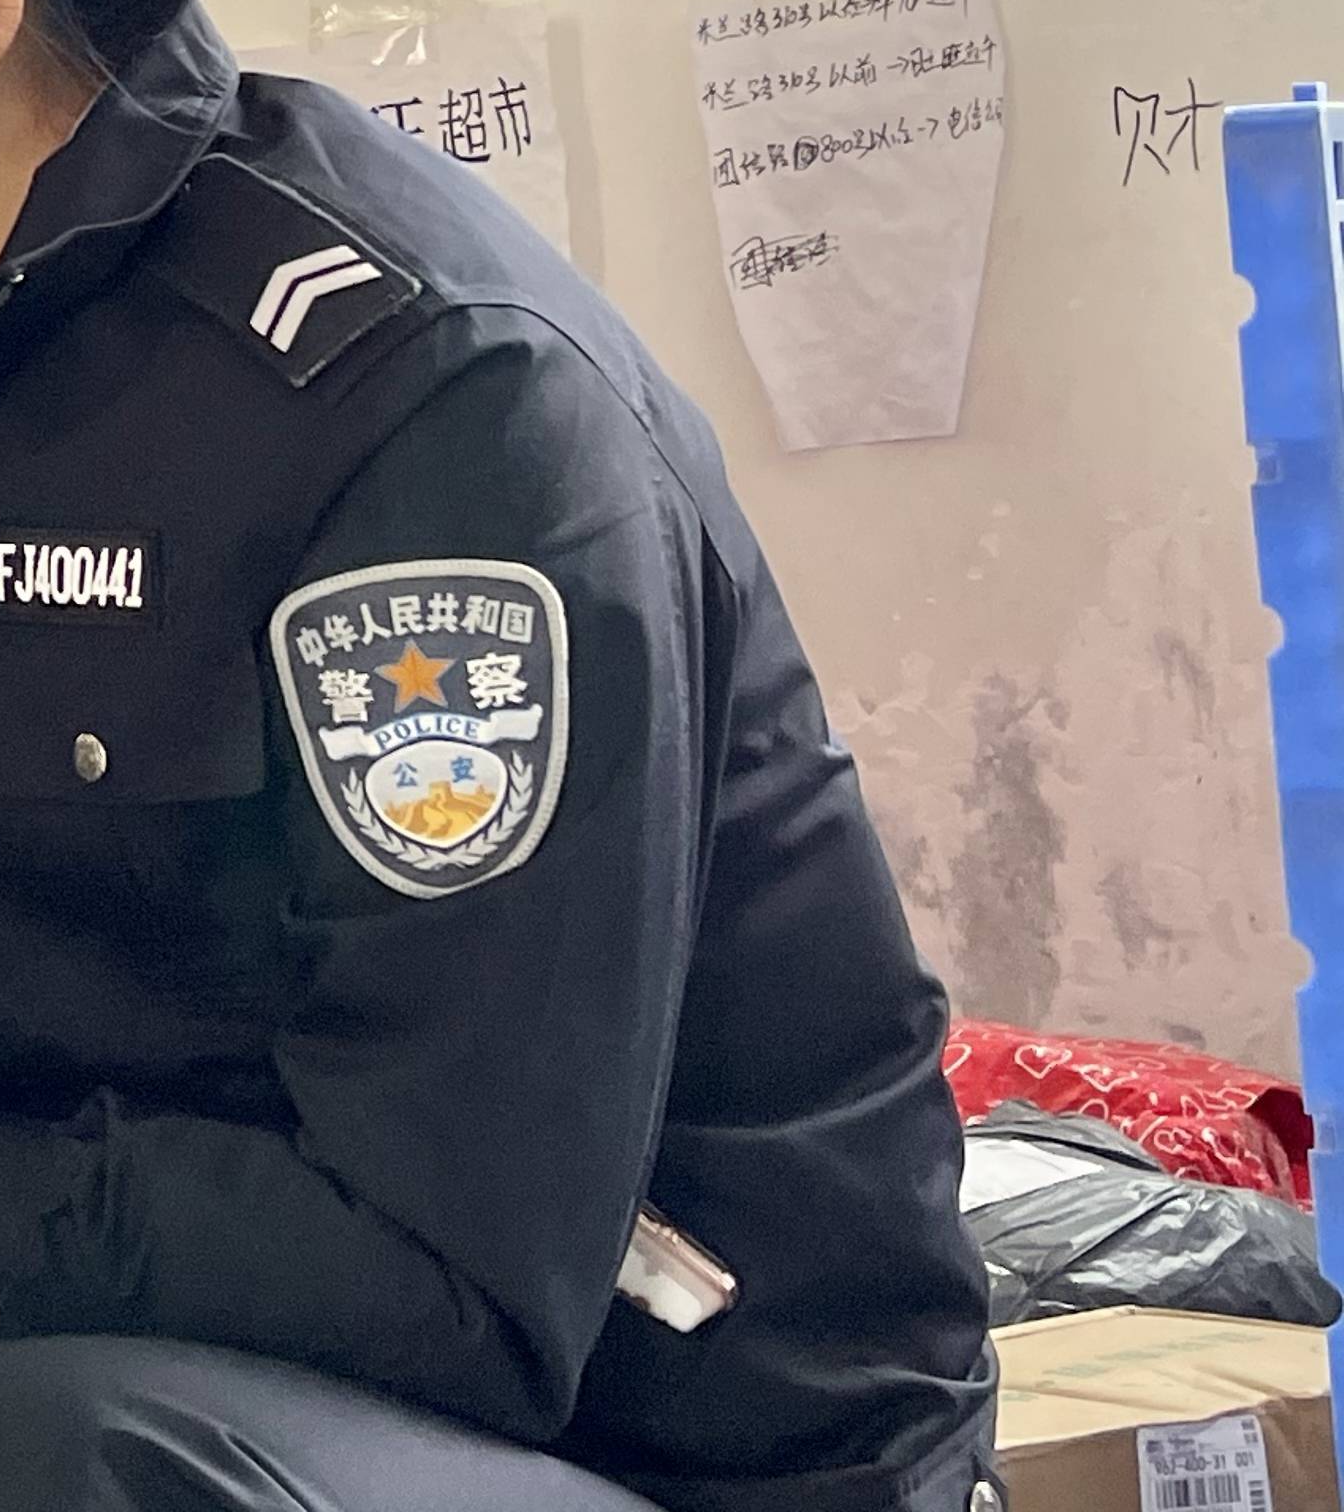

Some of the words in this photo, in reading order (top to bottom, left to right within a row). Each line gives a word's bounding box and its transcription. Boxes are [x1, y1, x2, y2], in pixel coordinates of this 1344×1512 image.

[295, 592, 535, 667] 中华人民共和国
[373, 716, 481, 751] POLICE
[393, 755, 476, 788] 公安
